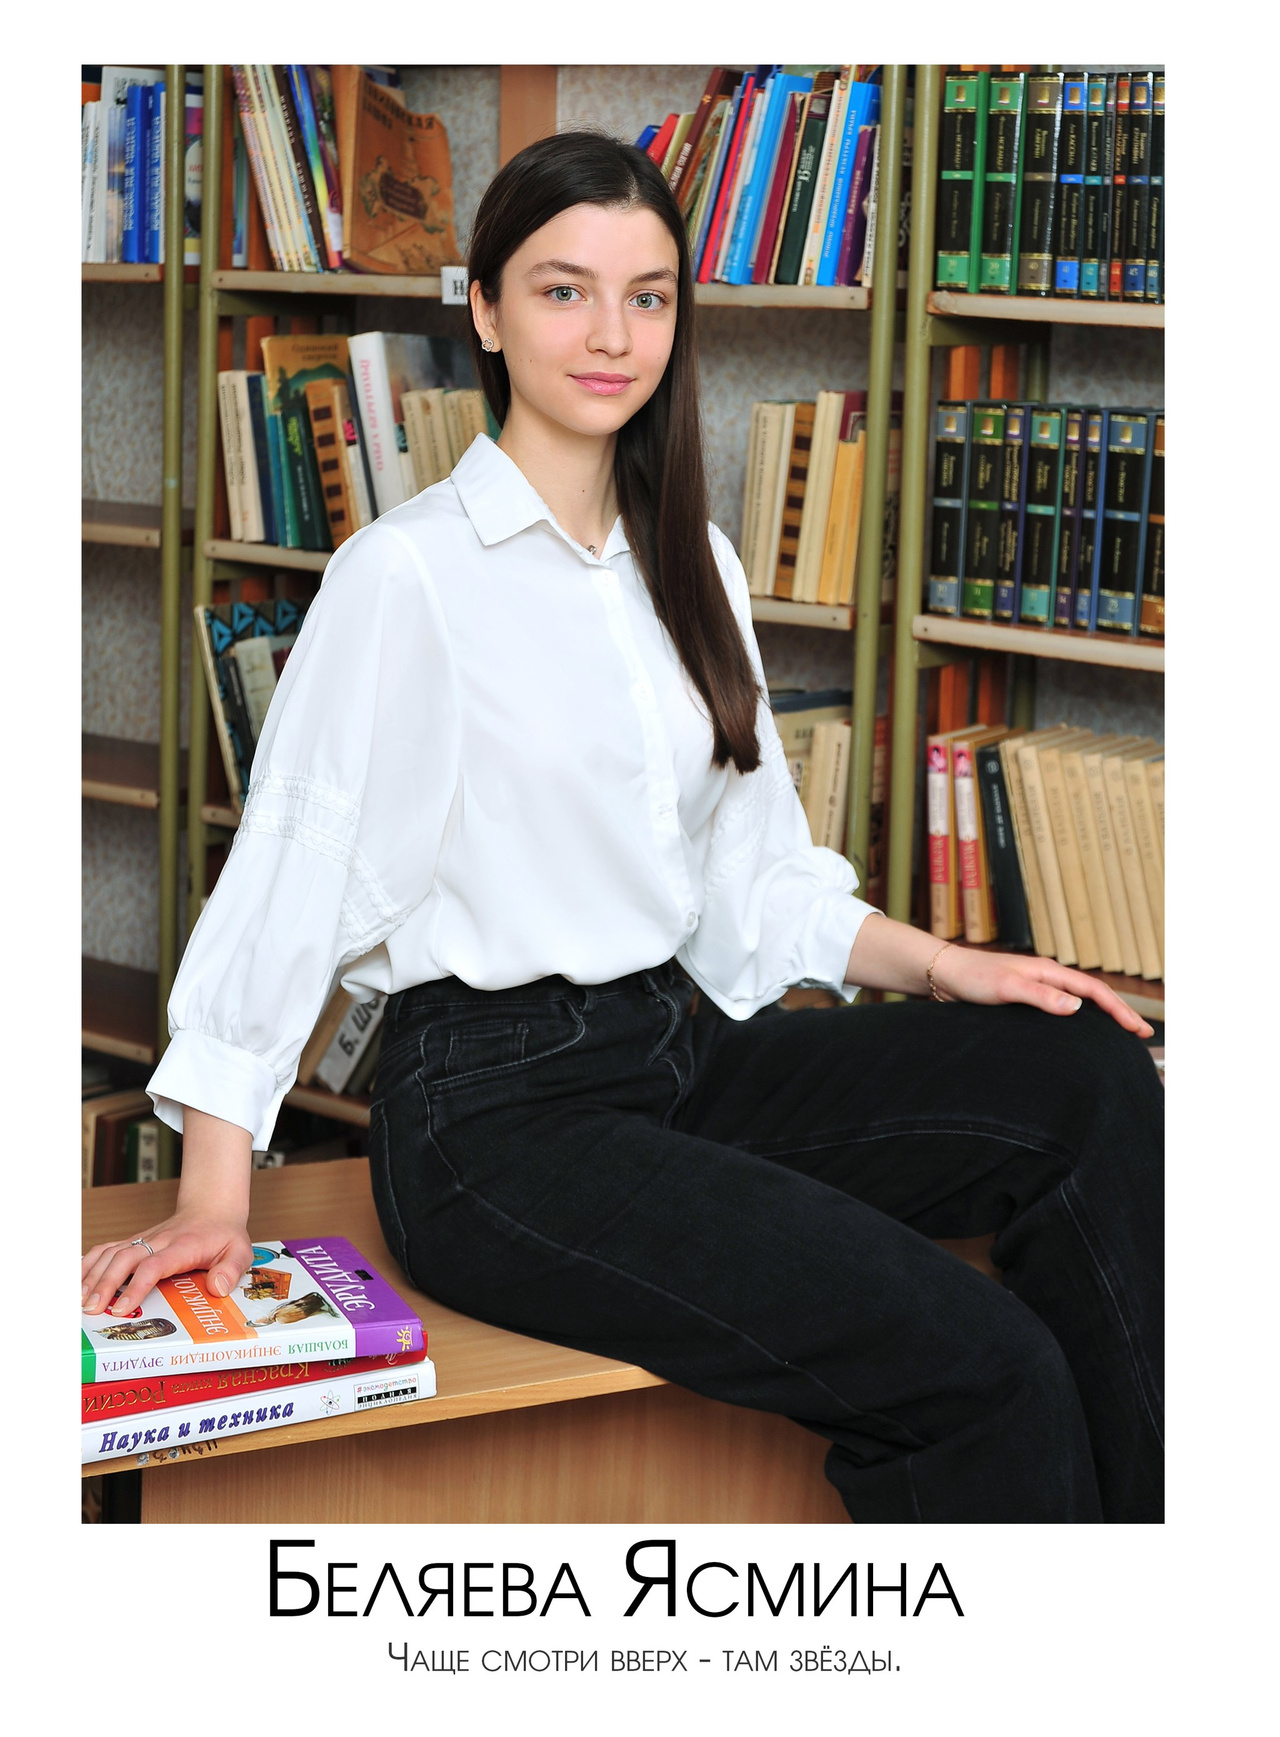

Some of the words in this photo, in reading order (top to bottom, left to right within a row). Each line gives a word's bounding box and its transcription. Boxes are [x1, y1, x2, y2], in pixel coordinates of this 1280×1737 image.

[296, 1245, 376, 1313] ЭРУДИТА
[170, 1345, 282, 1366] ЭНЦИКЛОПЕДИЯ
[288, 1338, 349, 1355] БОЛЬШАЯ
[102, 1355, 165, 1373] ЭРУДИТА
[218, 1362, 310, 1390] Красная
[171, 1377, 212, 1394] книга
[356, 1377, 417, 1394] #эксмодетство
[361, 1388, 413, 1403] ПОЛНАЯ
[98, 1424, 170, 1454] Наука
[178, 1418, 192, 1432] и
[199, 1400, 294, 1433] техника
